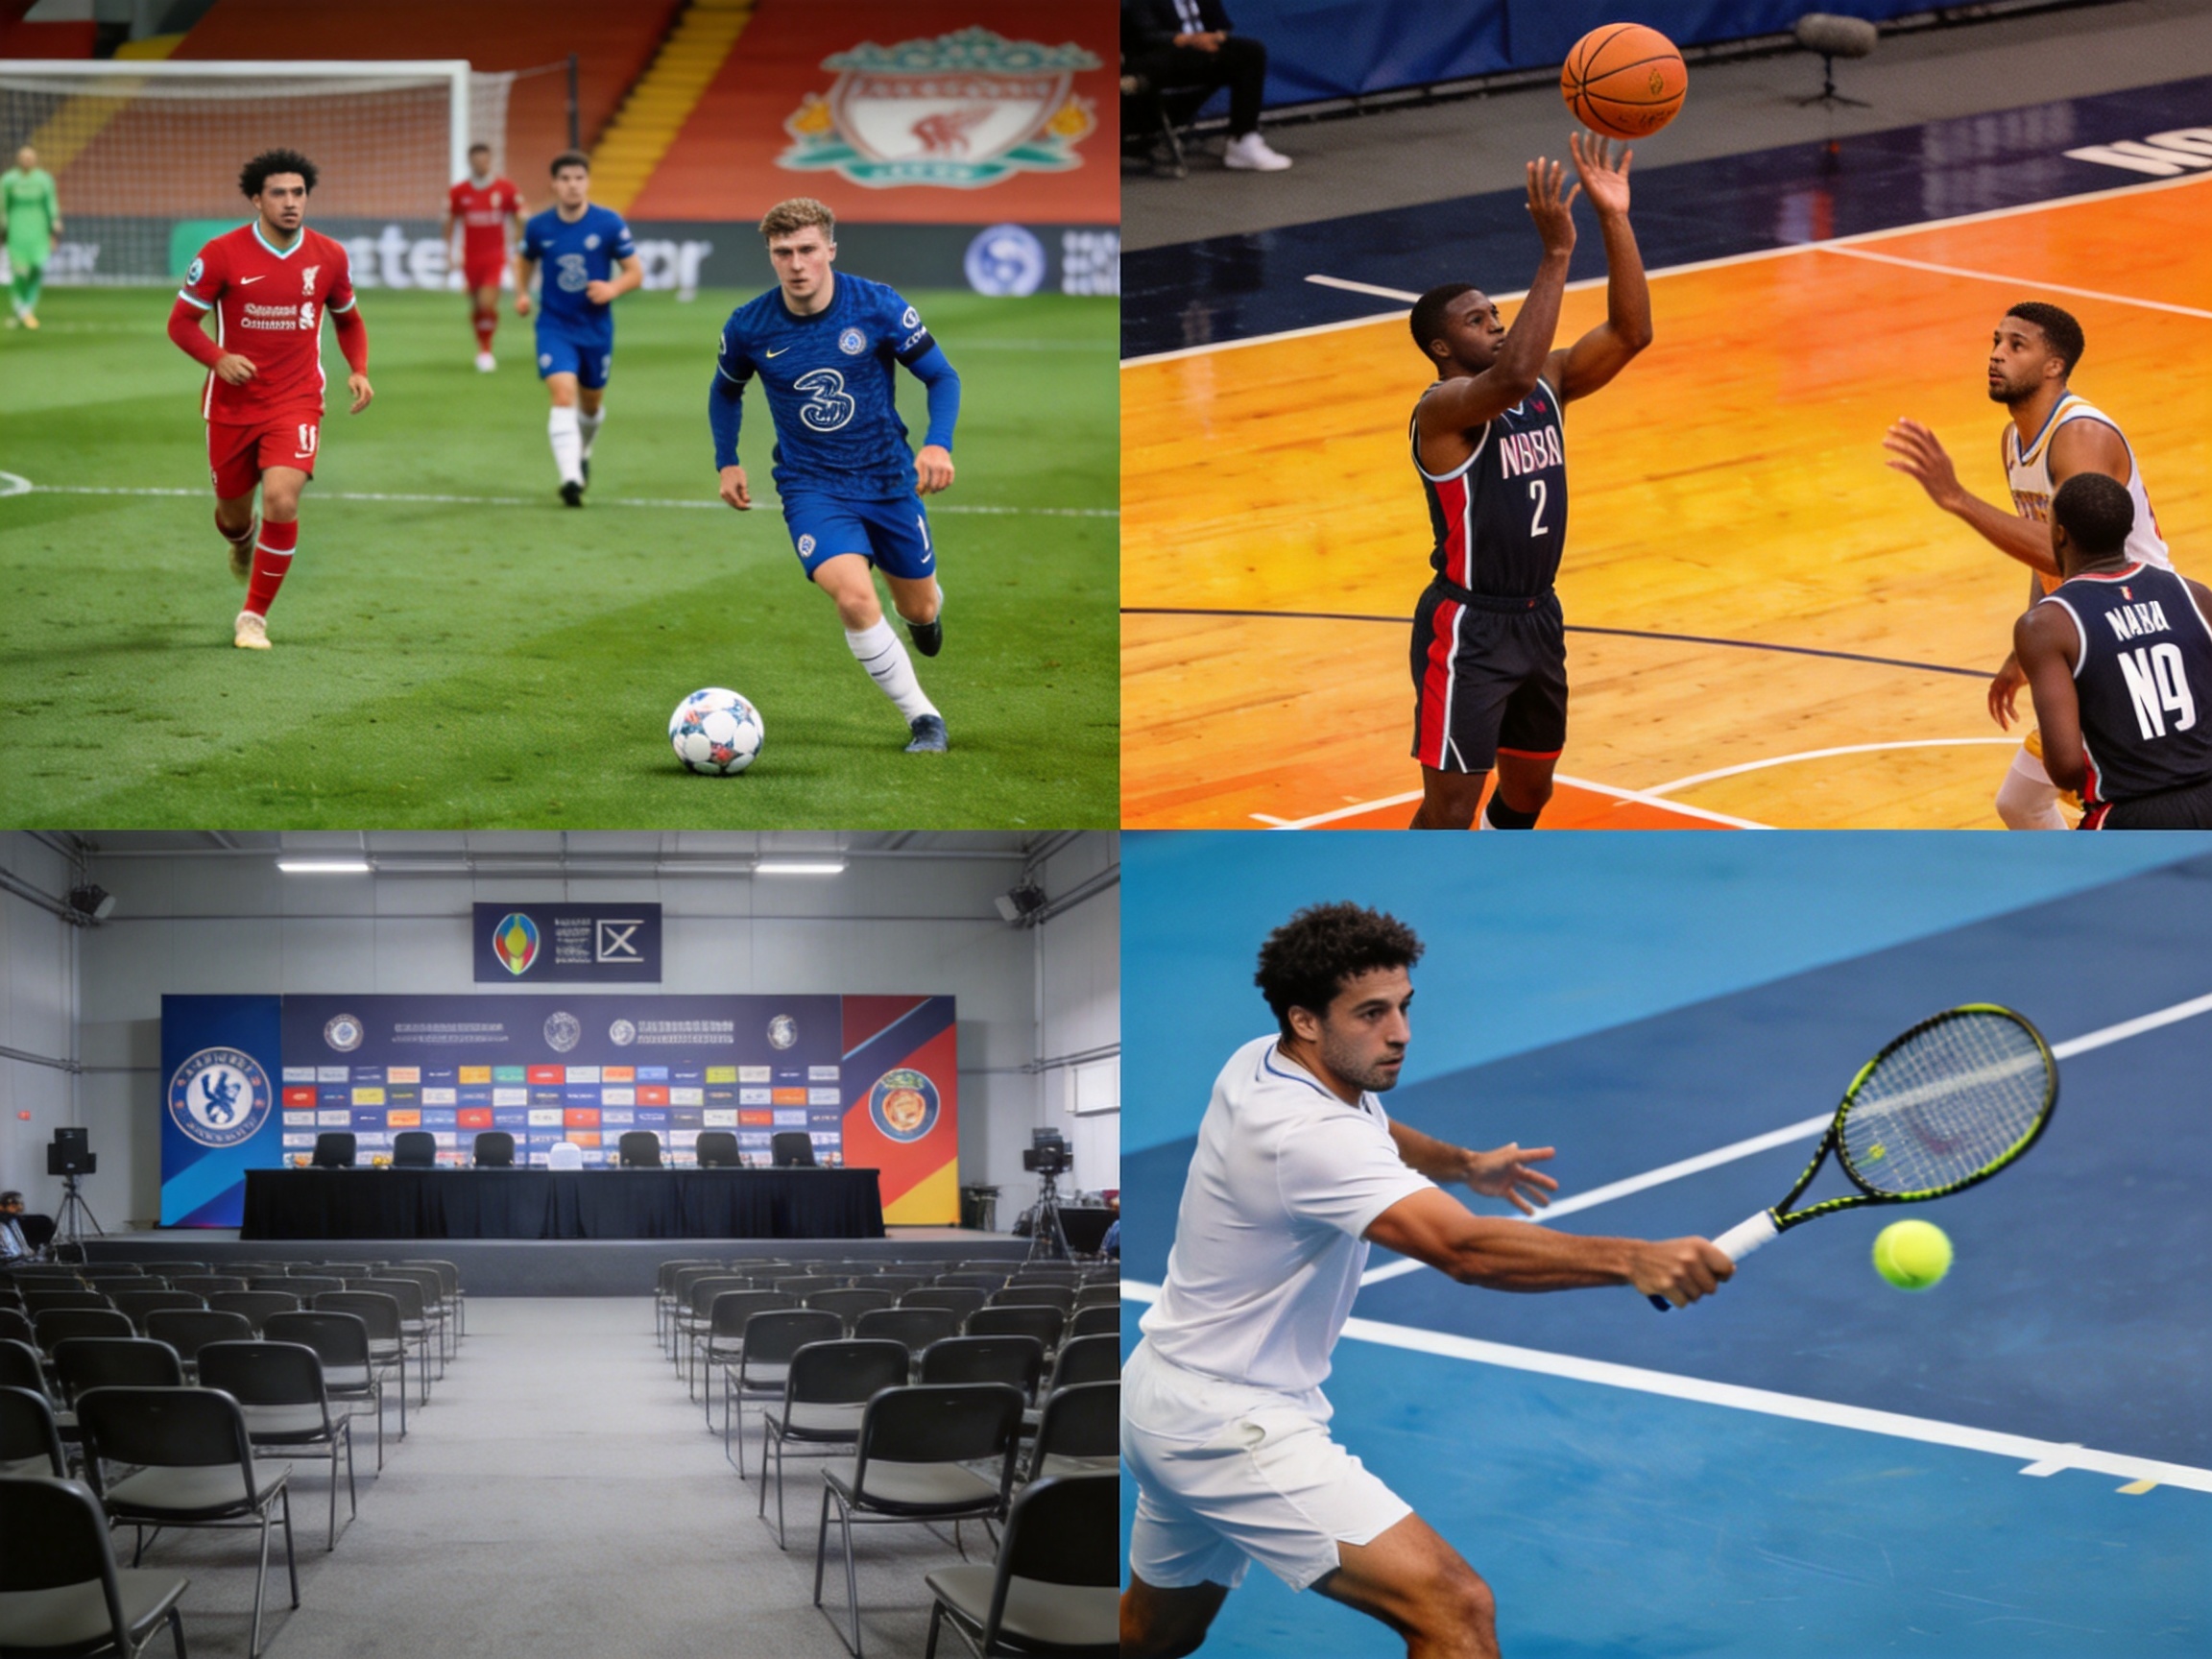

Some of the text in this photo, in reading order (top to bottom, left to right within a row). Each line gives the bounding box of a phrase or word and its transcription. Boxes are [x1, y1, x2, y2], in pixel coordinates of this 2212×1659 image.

[793, 368, 855, 431] 3
[1529, 480, 1549, 537] 2
[2117, 642, 2197, 740] N9
